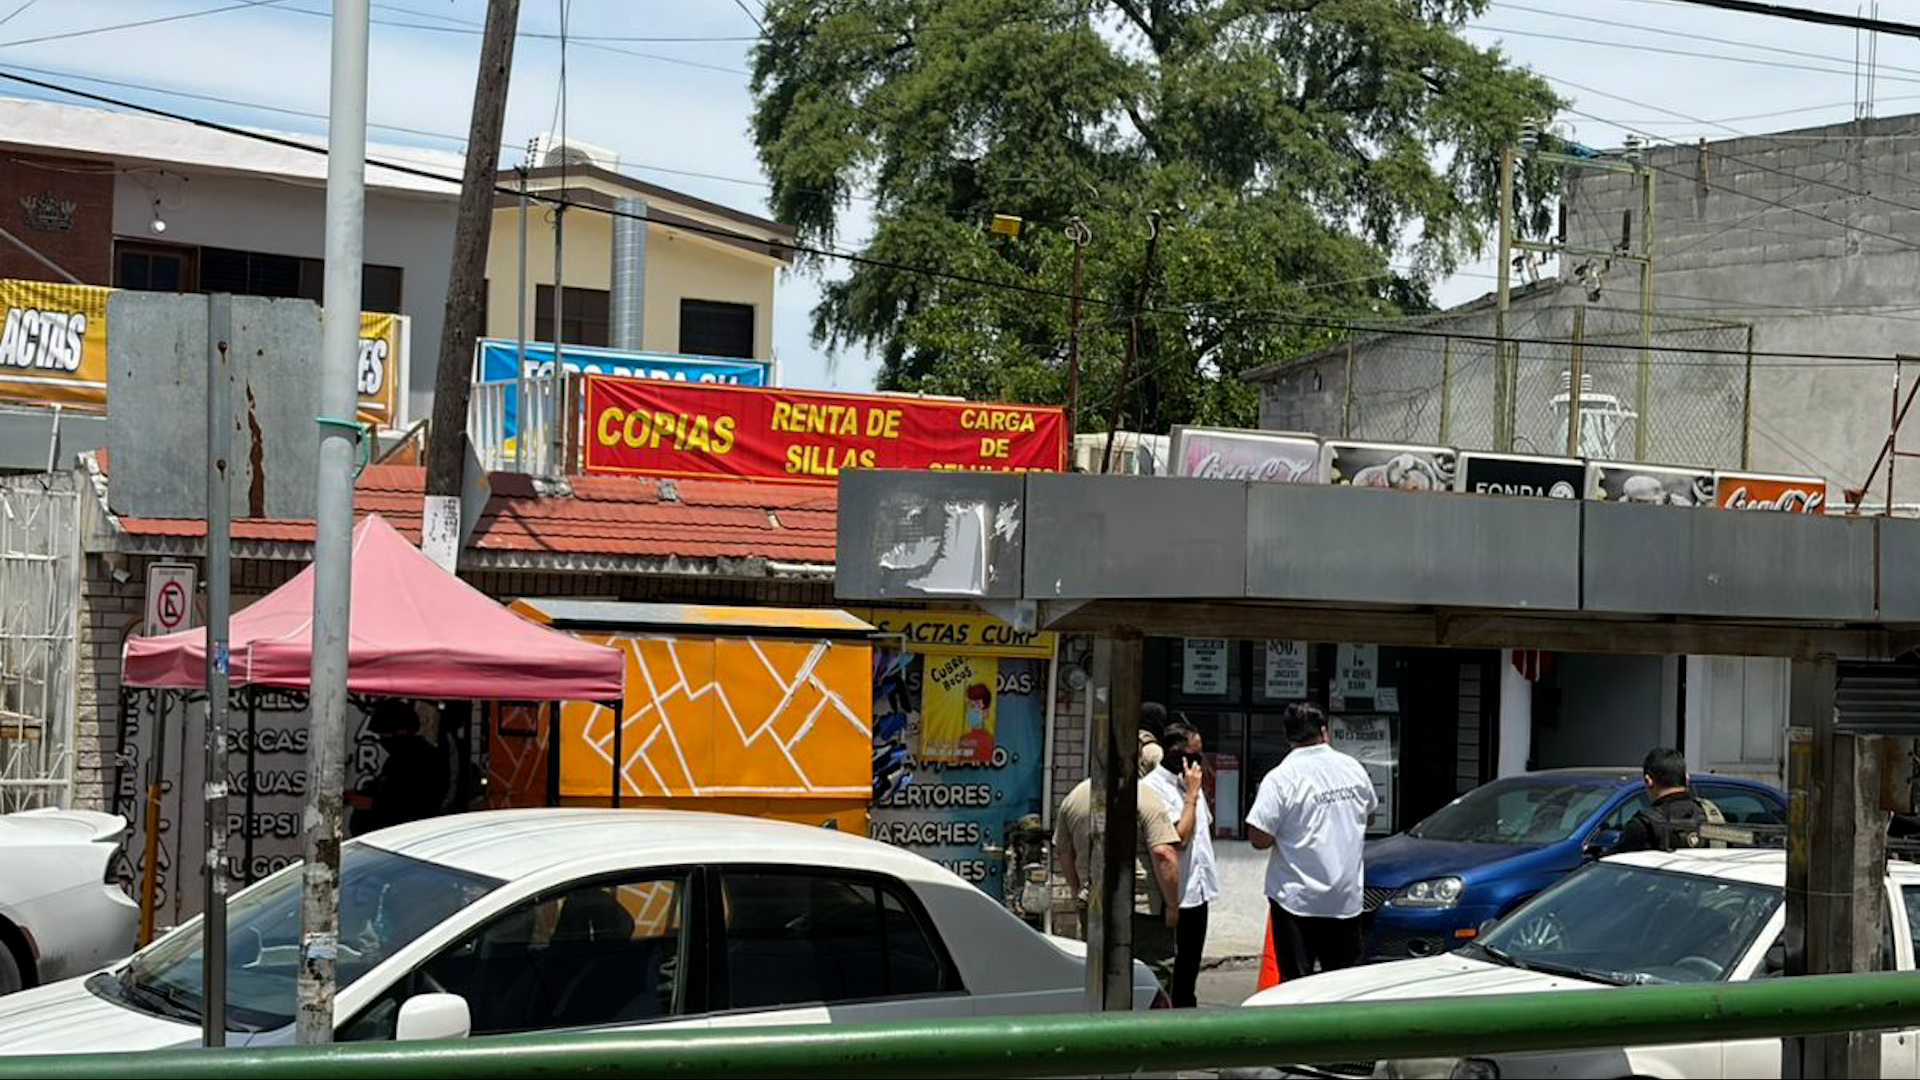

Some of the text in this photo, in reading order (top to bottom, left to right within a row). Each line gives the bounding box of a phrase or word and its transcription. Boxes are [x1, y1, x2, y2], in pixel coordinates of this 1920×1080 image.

[1, 308, 86, 371] ACTAS
[597, 406, 736, 455] COPIAS
[771, 402, 902, 438] RENTA DE
[961, 409, 1036, 432] CARGA
[980, 437, 1010, 458] DE
[901, 623, 968, 643] ACTAS
[227, 814, 297, 834] PEPSI
